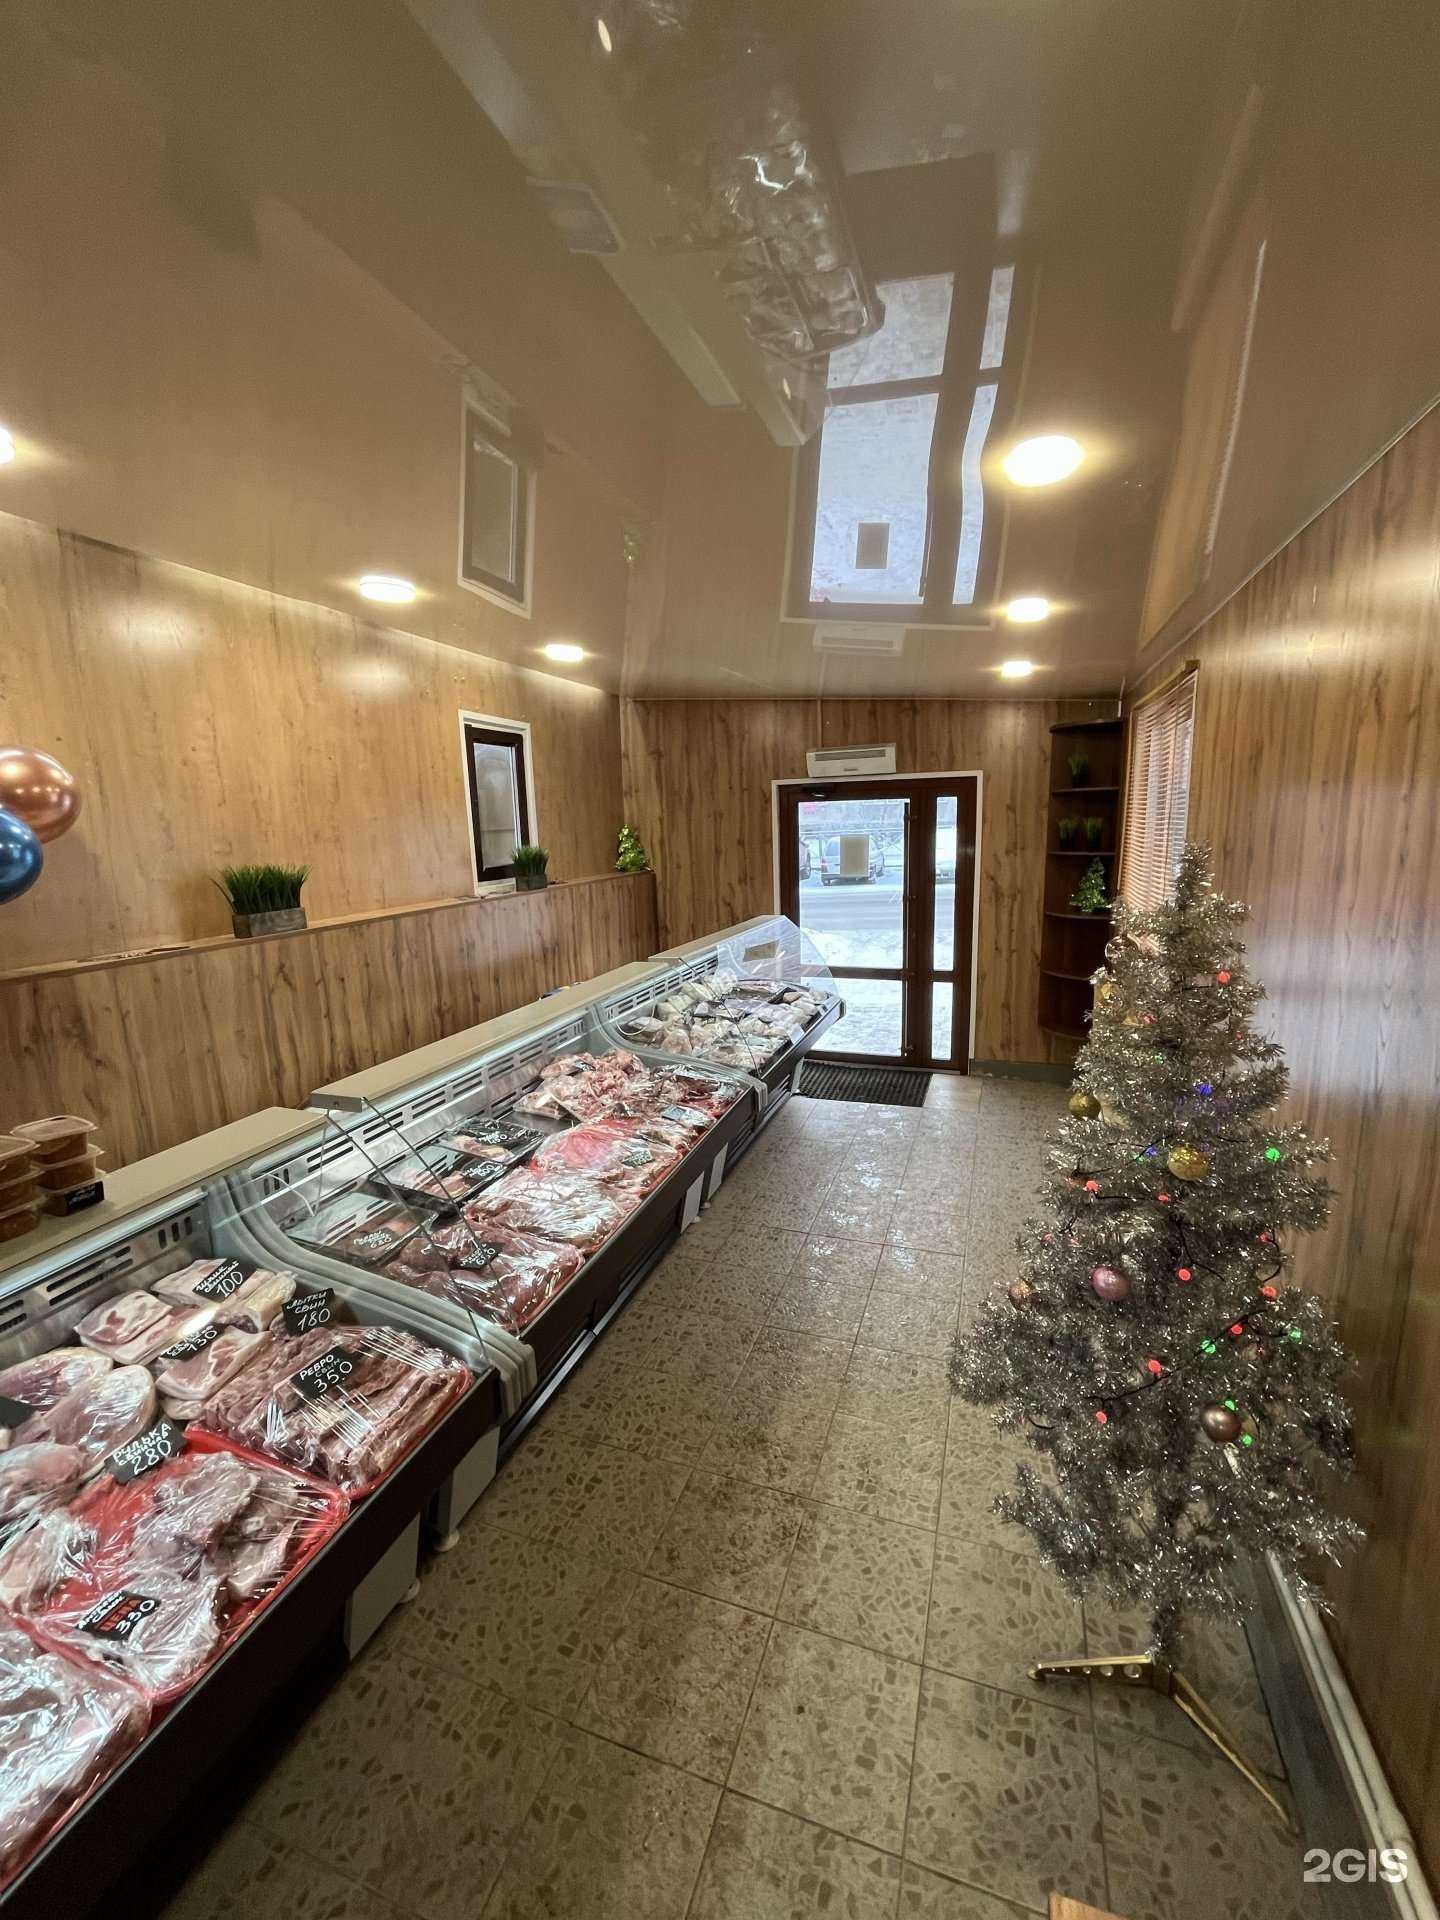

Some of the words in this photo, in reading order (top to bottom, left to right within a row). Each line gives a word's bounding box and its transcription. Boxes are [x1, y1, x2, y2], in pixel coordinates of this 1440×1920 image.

[216, 1271, 243, 1298] 100
[297, 1308, 331, 1332] 180
[187, 1330, 217, 1351] 130
[299, 1354, 334, 1381] РЕБРО
[313, 1361, 353, 1393] 350
[131, 1440, 171, 1475] 280
[115, 1599, 155, 1635] 330
